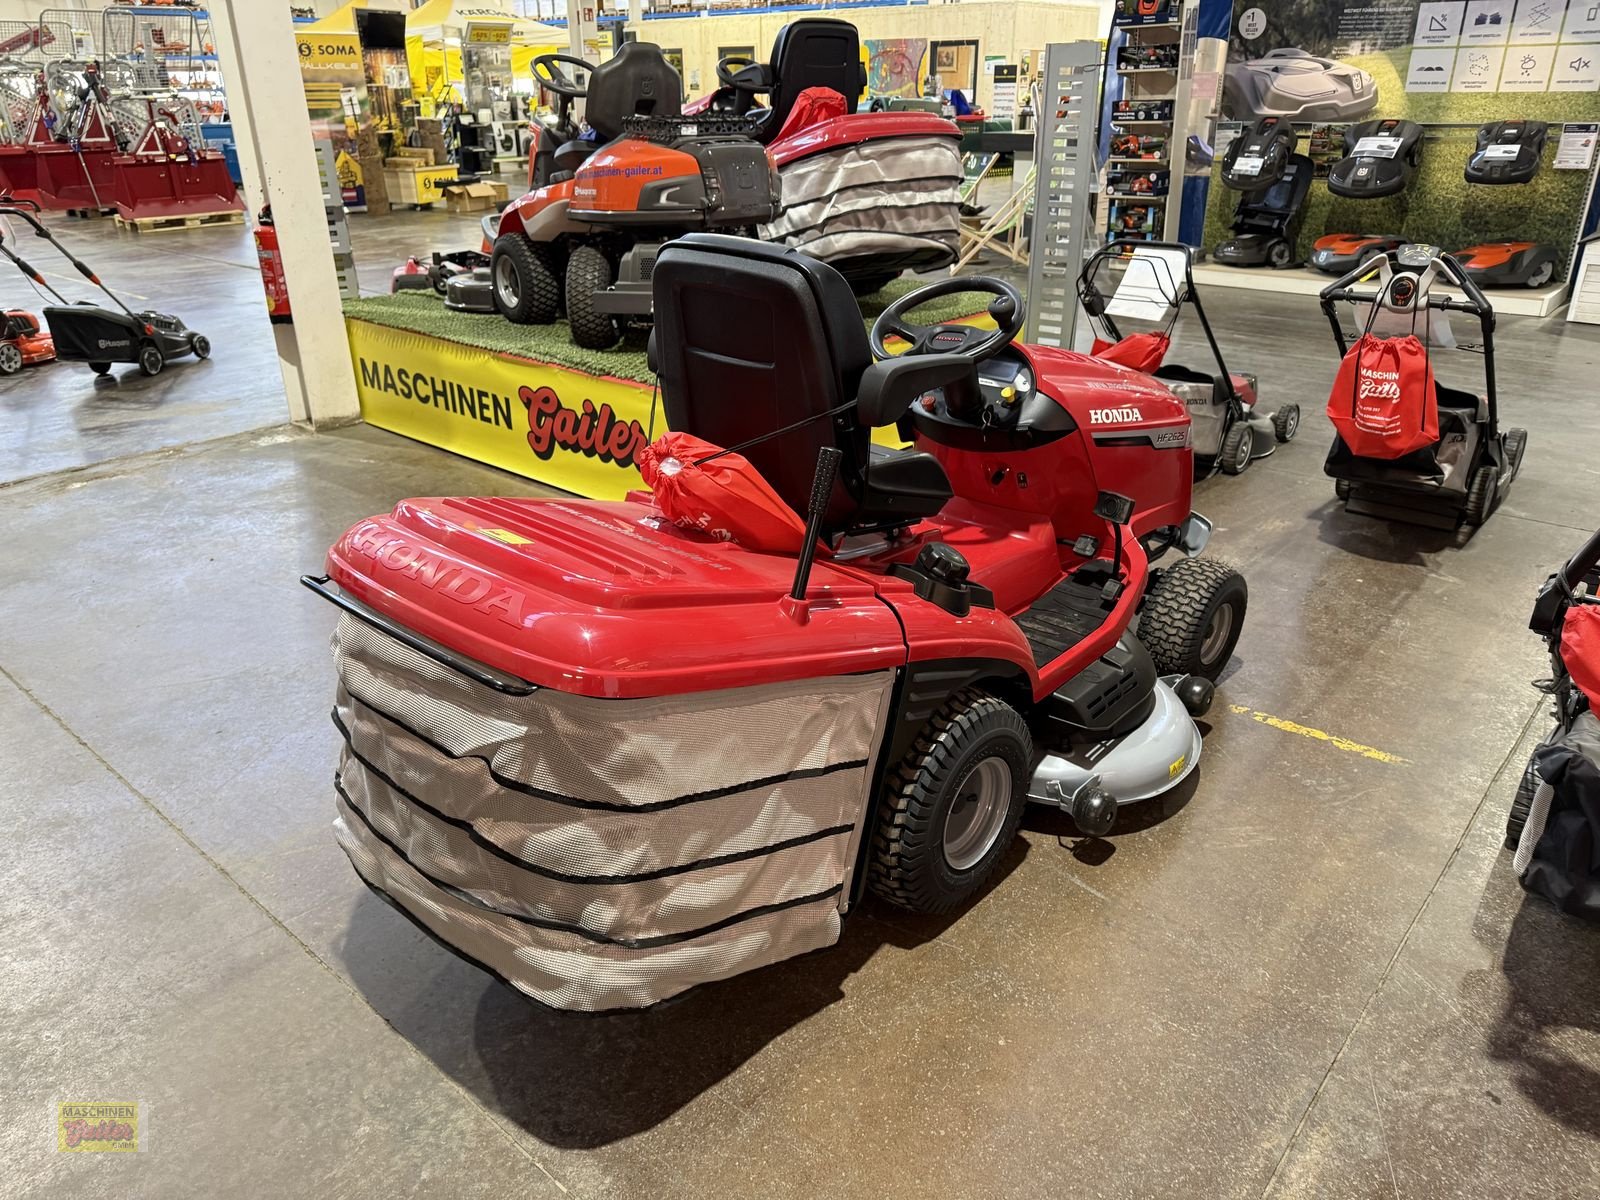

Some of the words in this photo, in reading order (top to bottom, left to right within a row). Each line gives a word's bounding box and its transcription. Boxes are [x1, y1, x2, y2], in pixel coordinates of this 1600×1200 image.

[318, 45, 356, 56] SOMA
[359, 357, 513, 430] MASCHINEN
[518, 385, 649, 470] Gailer
[1089, 408, 1143, 424] HONDA
[351, 526, 526, 631] HONDA
